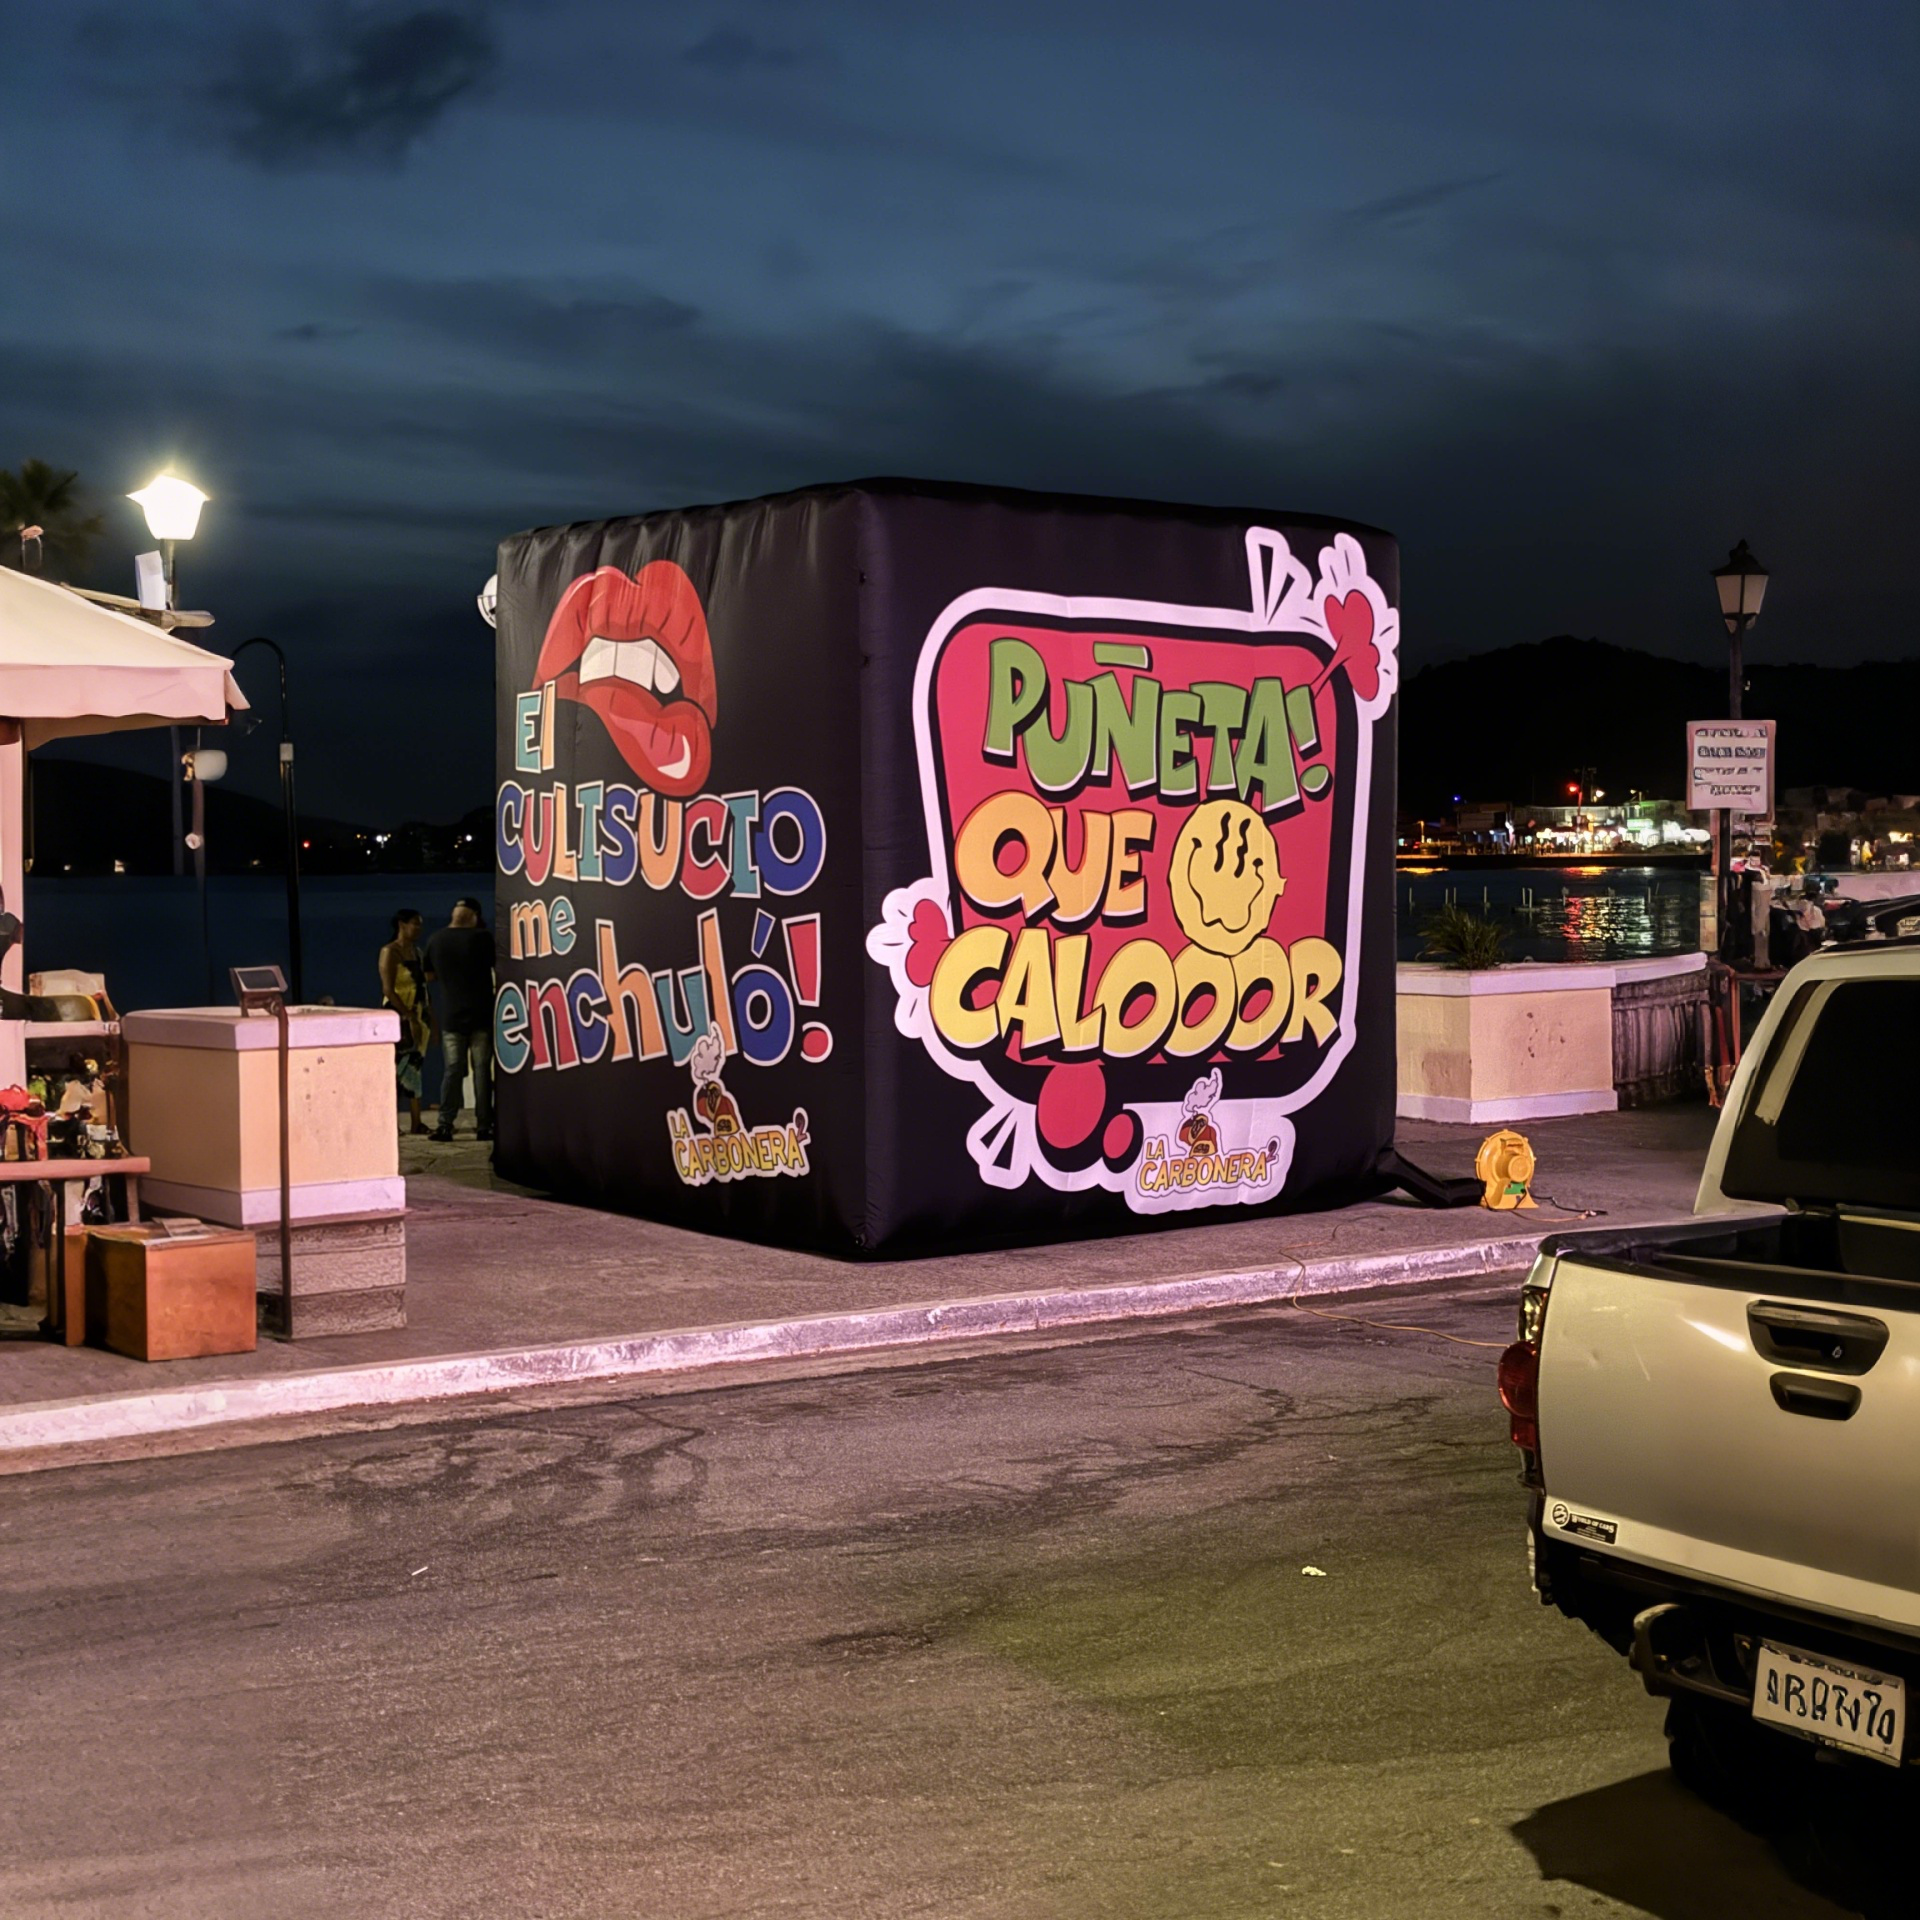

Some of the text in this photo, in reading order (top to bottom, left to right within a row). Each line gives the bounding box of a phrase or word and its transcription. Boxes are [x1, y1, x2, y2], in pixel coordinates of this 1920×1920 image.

[983, 637, 1333, 813] PUÑETA!
[496, 780, 827, 900] CULISUCIO
[955, 790, 1156, 922] QUE
[510, 895, 577, 960] me
[930, 925, 1343, 1058] CALOOOR
[670, 1112, 691, 1139] LA
[1145, 1139, 1166, 1160] LA
